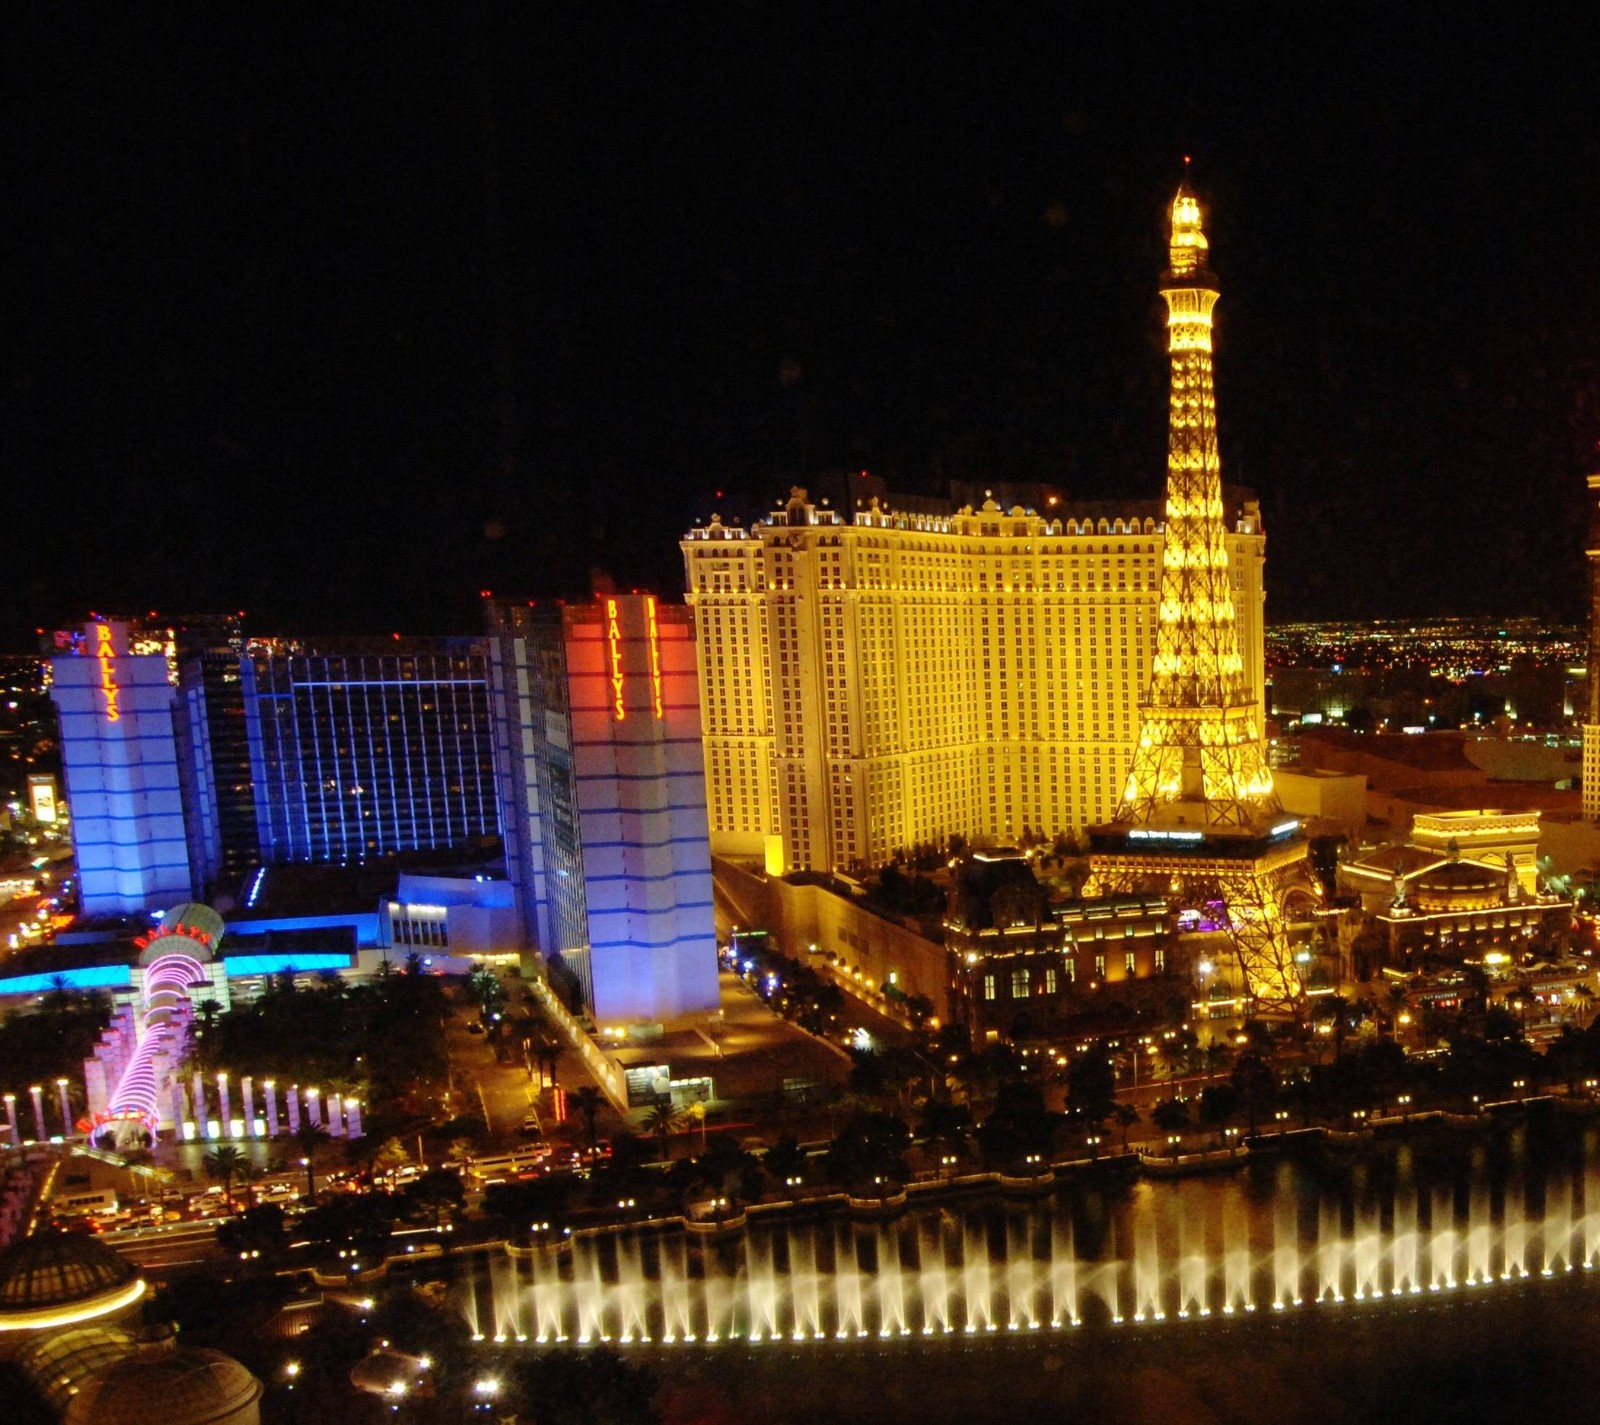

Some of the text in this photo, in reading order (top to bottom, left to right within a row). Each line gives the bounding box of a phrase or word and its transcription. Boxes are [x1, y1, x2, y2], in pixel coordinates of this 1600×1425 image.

[96, 624, 120, 722] BALLYS
[607, 599, 625, 721] BALLYS
[647, 598, 663, 720] BALLYS
